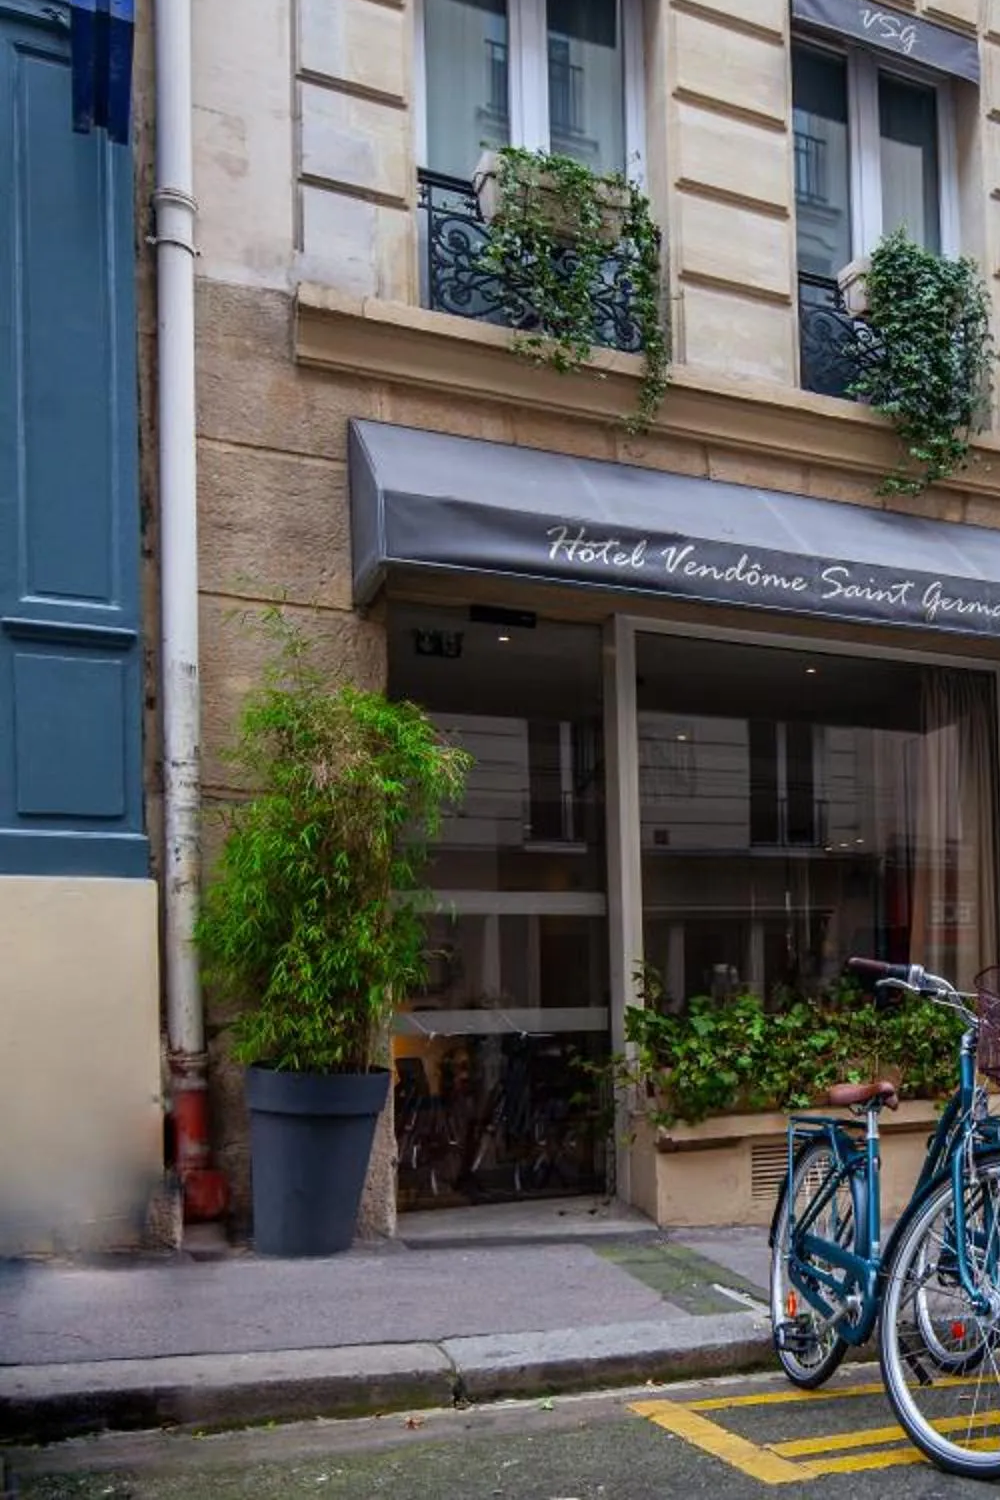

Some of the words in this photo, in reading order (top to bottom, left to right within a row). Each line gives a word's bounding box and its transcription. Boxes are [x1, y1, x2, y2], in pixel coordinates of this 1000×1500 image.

[859, 8, 918, 55] VSG
[660, 544, 809, 592] Vendôme
[821, 565, 915, 607] Saint
